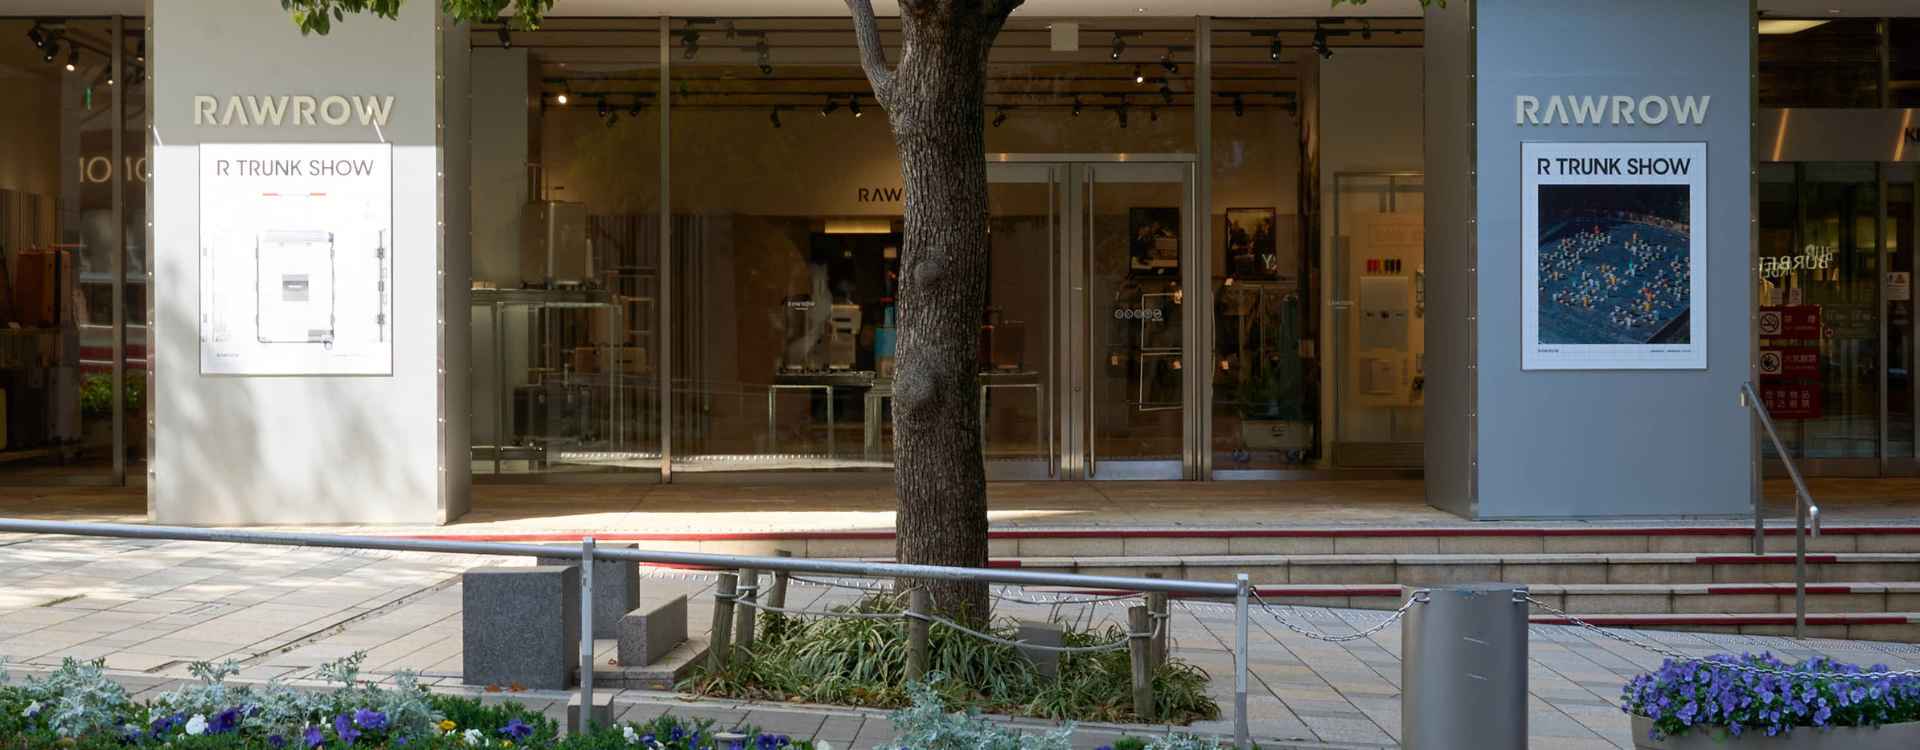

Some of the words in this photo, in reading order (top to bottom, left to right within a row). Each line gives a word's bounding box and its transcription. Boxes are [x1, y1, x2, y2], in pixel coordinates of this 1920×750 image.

[194, 95, 395, 126] RAWROW
[1516, 95, 1711, 126] RAWROW
[217, 160, 229, 176] R
[239, 160, 302, 176] TRUNK
[308, 160, 375, 176] SHOW
[1537, 158, 1550, 175] R
[1556, 158, 1621, 175] TRUNK
[1627, 158, 1691, 175] SHOW
